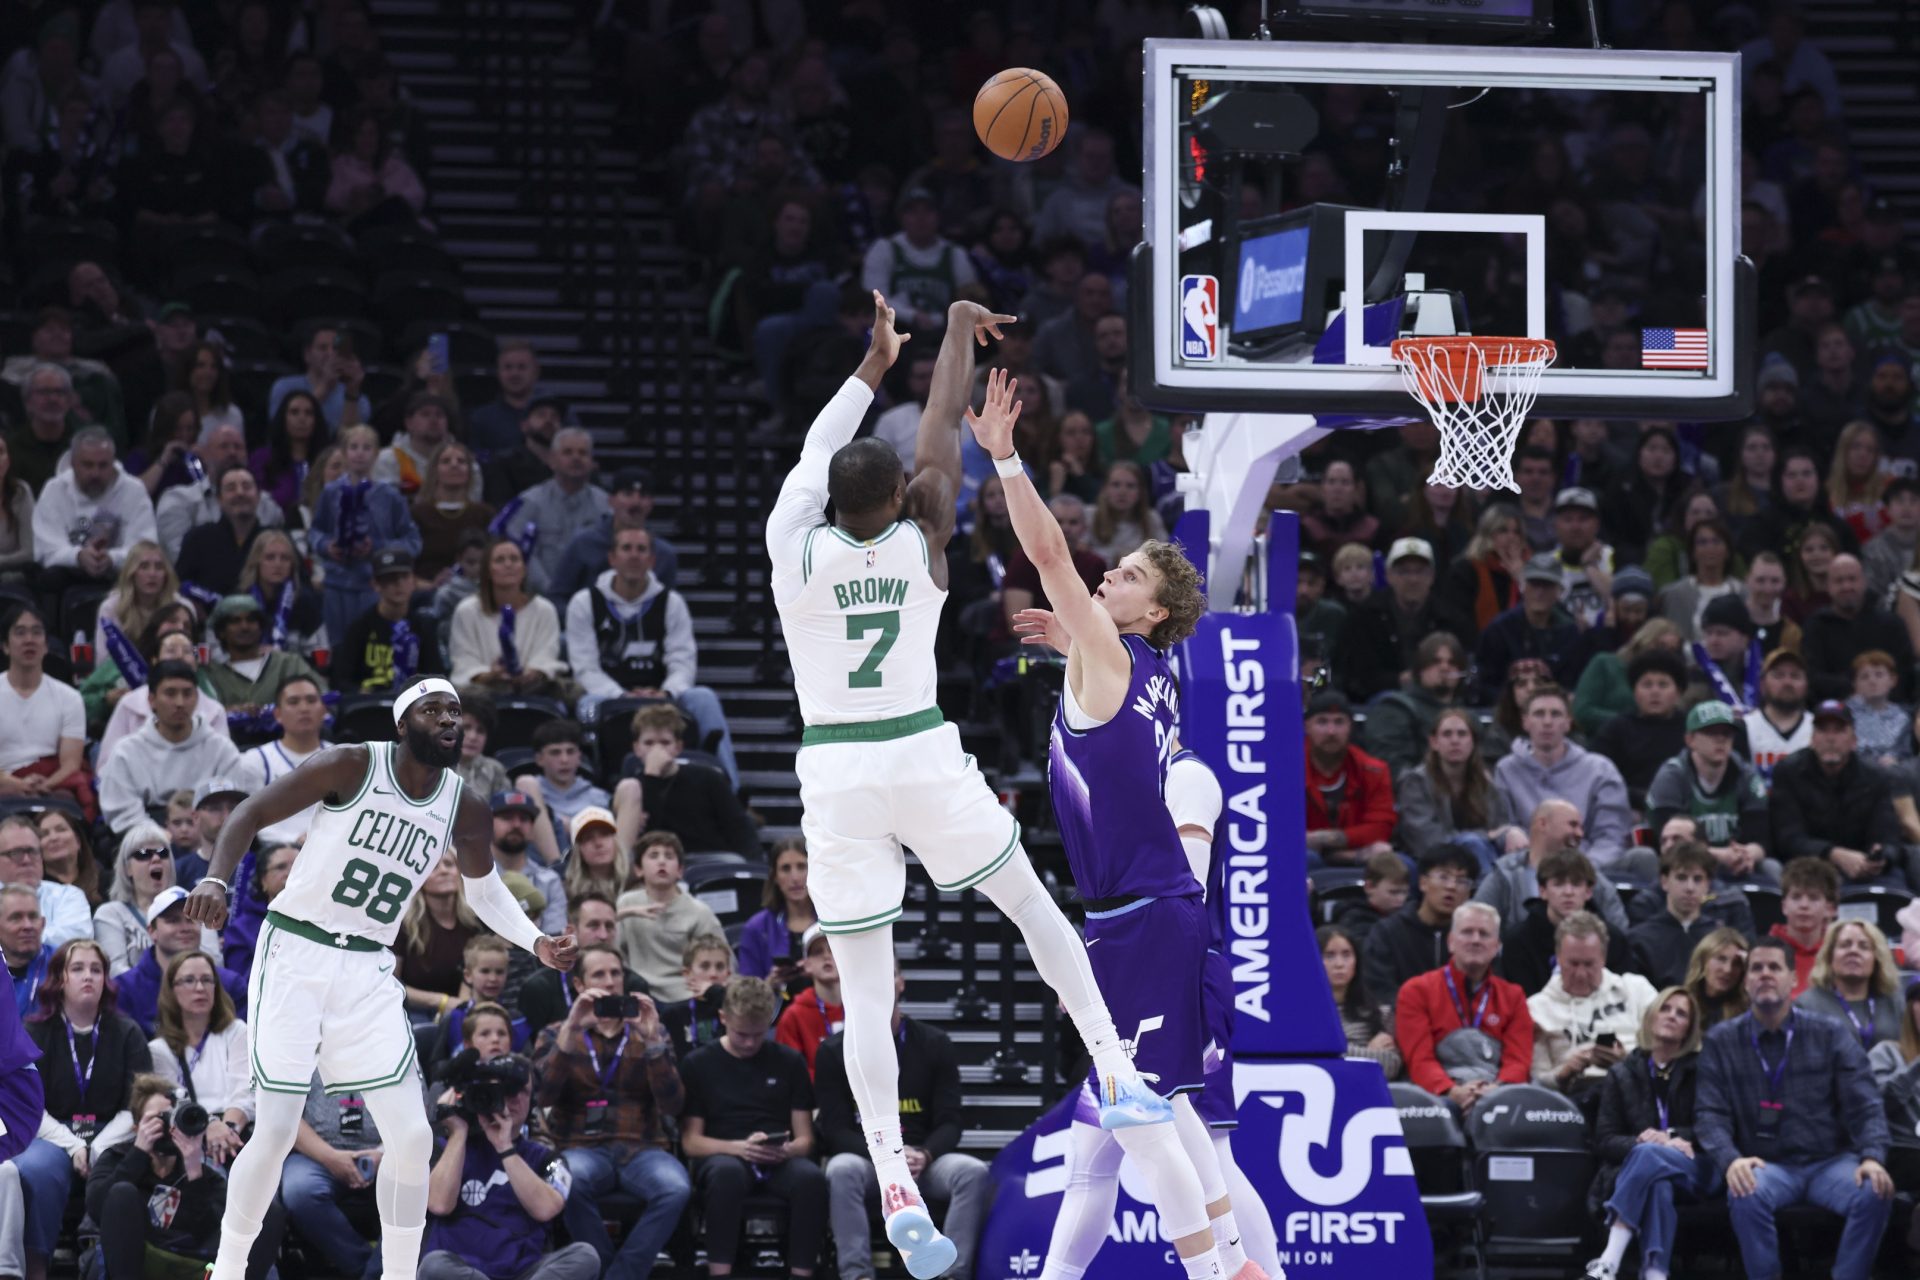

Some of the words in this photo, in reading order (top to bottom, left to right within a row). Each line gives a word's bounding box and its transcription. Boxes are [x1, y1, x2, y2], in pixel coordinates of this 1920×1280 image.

[1185, 341, 1204, 355] NBA
[833, 577, 909, 610] BROWN
[846, 610, 900, 688] 7
[1220, 627, 1267, 774] FIRST
[348, 809, 438, 875] CELTICS
[331, 857, 413, 925] 88
[1228, 783, 1271, 1023] AMERICA
[1279, 1250, 1334, 1265] NION
[1285, 1211, 1406, 1244] FIRST
